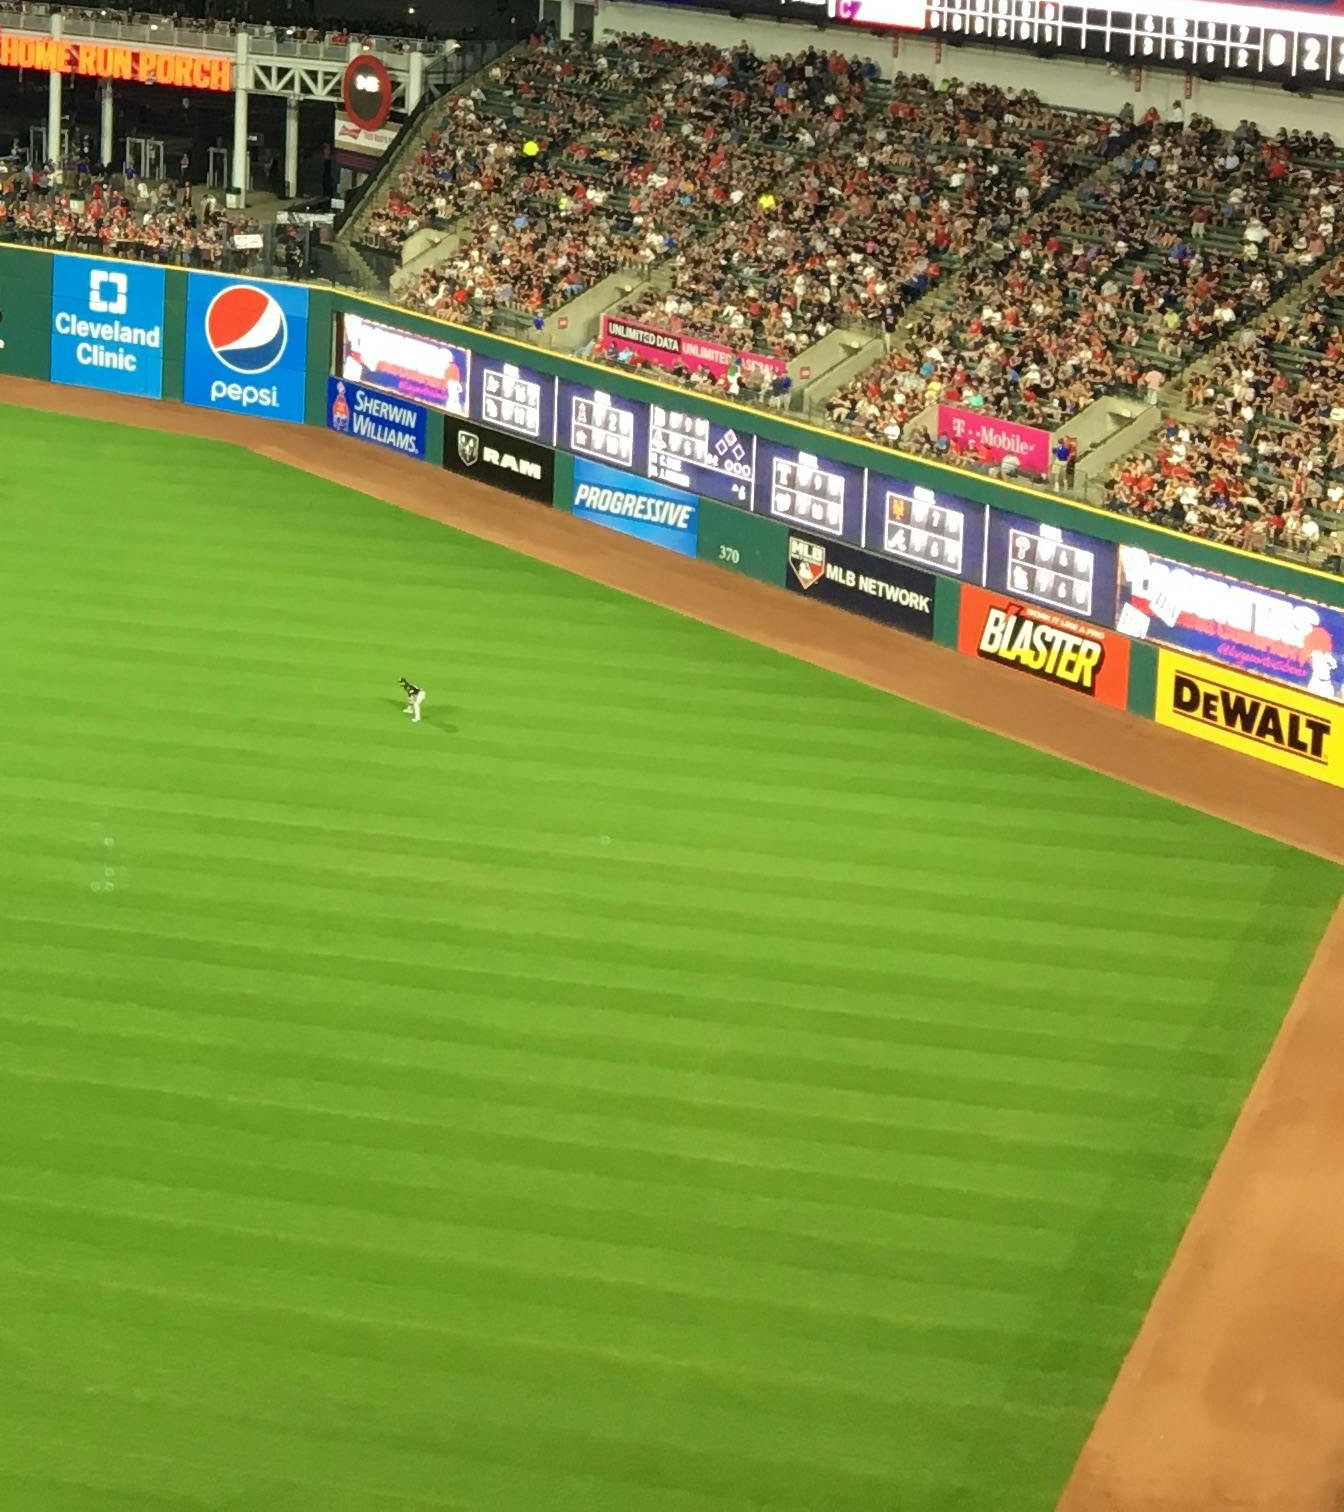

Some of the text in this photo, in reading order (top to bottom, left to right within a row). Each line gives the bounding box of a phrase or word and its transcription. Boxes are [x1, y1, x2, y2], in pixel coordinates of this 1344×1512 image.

[0, 35, 231, 90] HOME RUN PORCH
[55, 312, 160, 348] Cleveland
[608, 322, 656, 344] UNLIMITED
[656, 336, 679, 352] DATA
[76, 343, 137, 372] Clinic
[210, 379, 279, 408] pepsi
[354, 390, 417, 429] SHERWIN
[482, 446, 541, 480] RAM
[575, 482, 693, 530] PROGRESSIVE
[719, 545, 740, 565] 370
[792, 539, 824, 562] MLB
[826, 562, 930, 614] MLB NETWORK
[979, 607, 1102, 687] BLASTER
